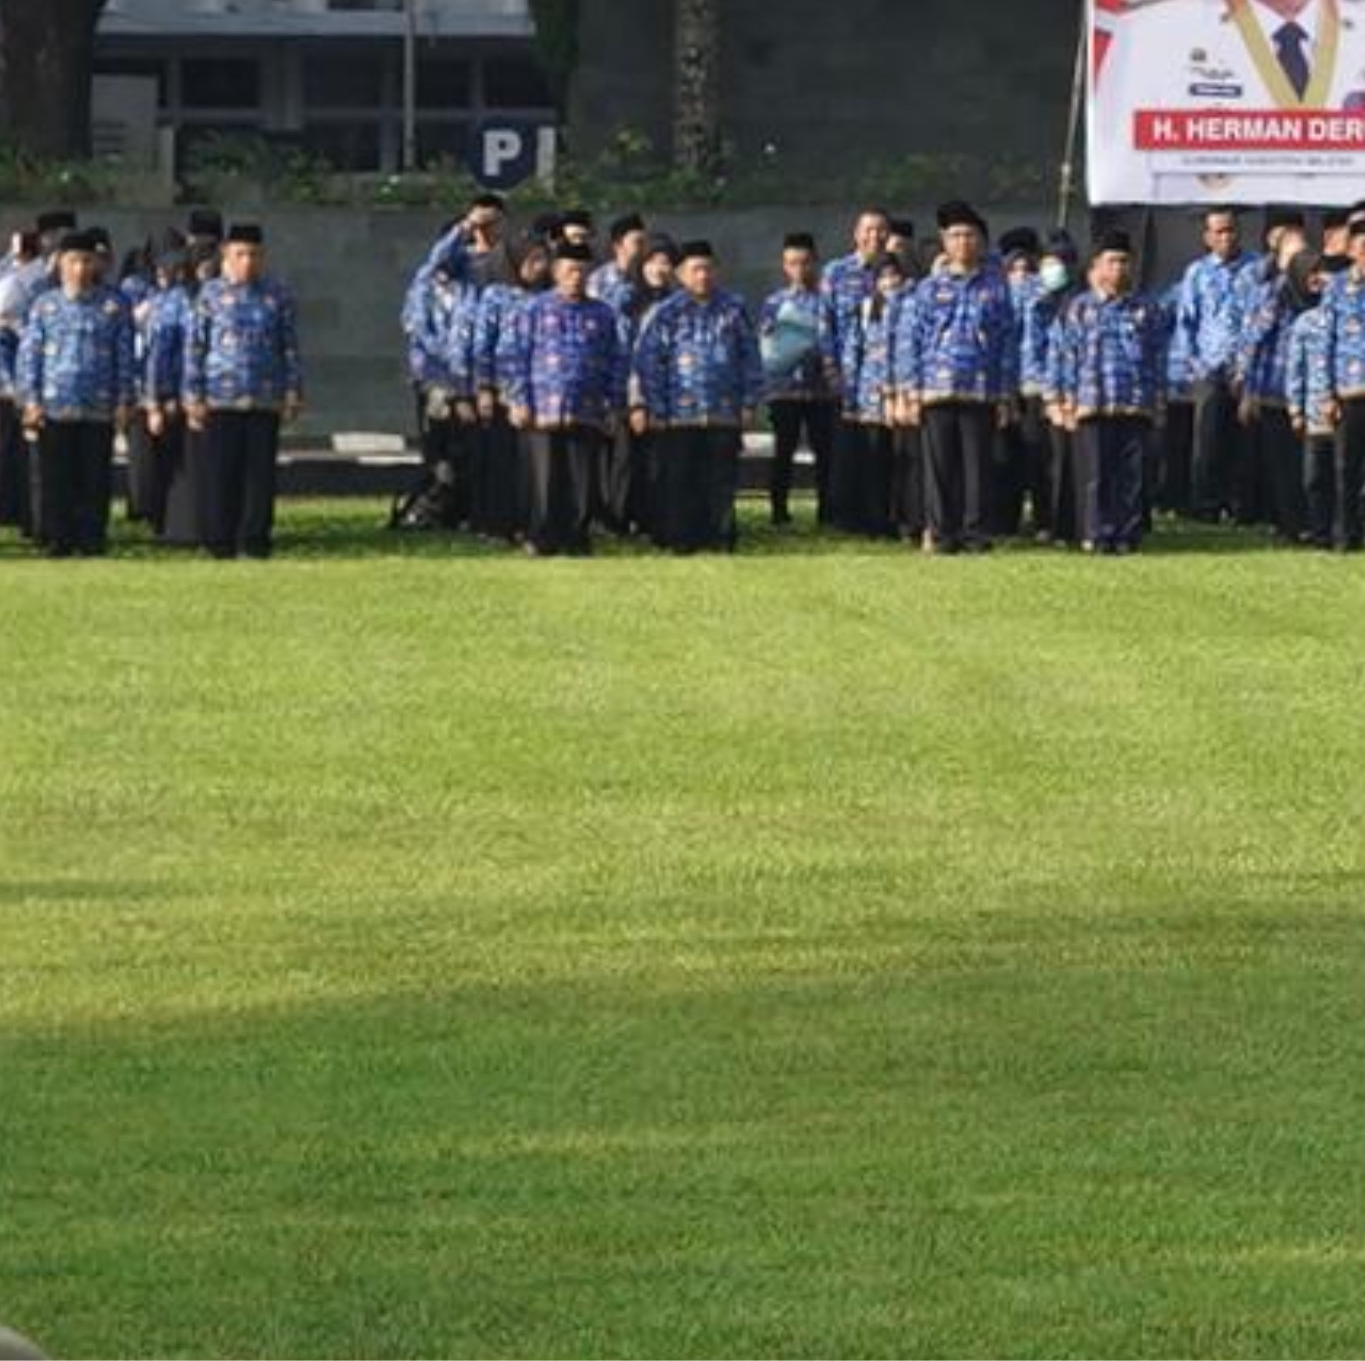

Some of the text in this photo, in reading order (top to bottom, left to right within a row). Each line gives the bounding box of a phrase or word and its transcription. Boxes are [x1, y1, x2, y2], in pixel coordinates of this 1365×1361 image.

[1152, 118, 1178, 141] H.
[1186, 118, 1300, 141] HERMAN
[482, 129, 522, 177] P
